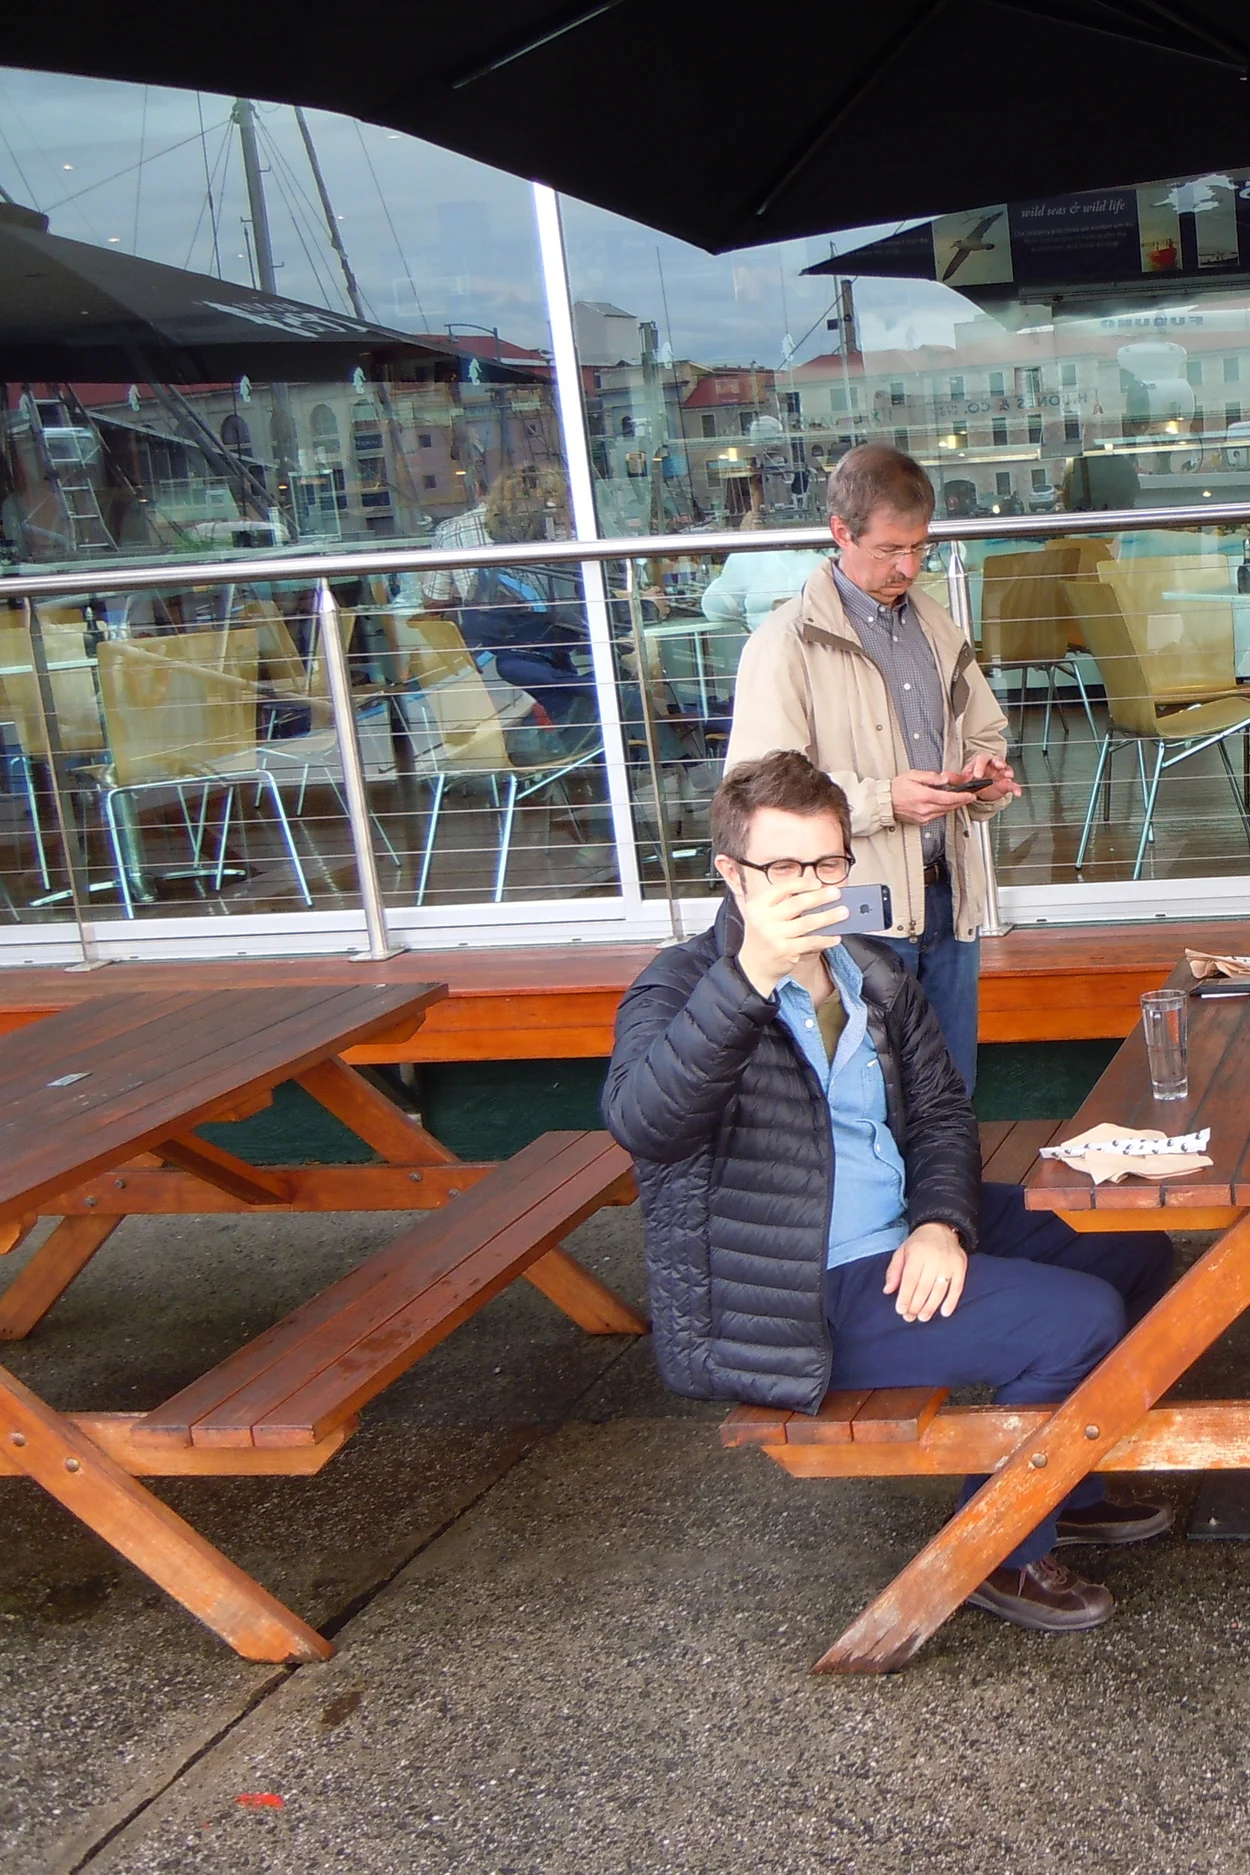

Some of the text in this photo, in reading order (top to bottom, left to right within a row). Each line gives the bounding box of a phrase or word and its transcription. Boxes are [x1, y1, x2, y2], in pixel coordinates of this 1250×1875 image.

[1021, 199, 1126, 218] wild seas & wild life
